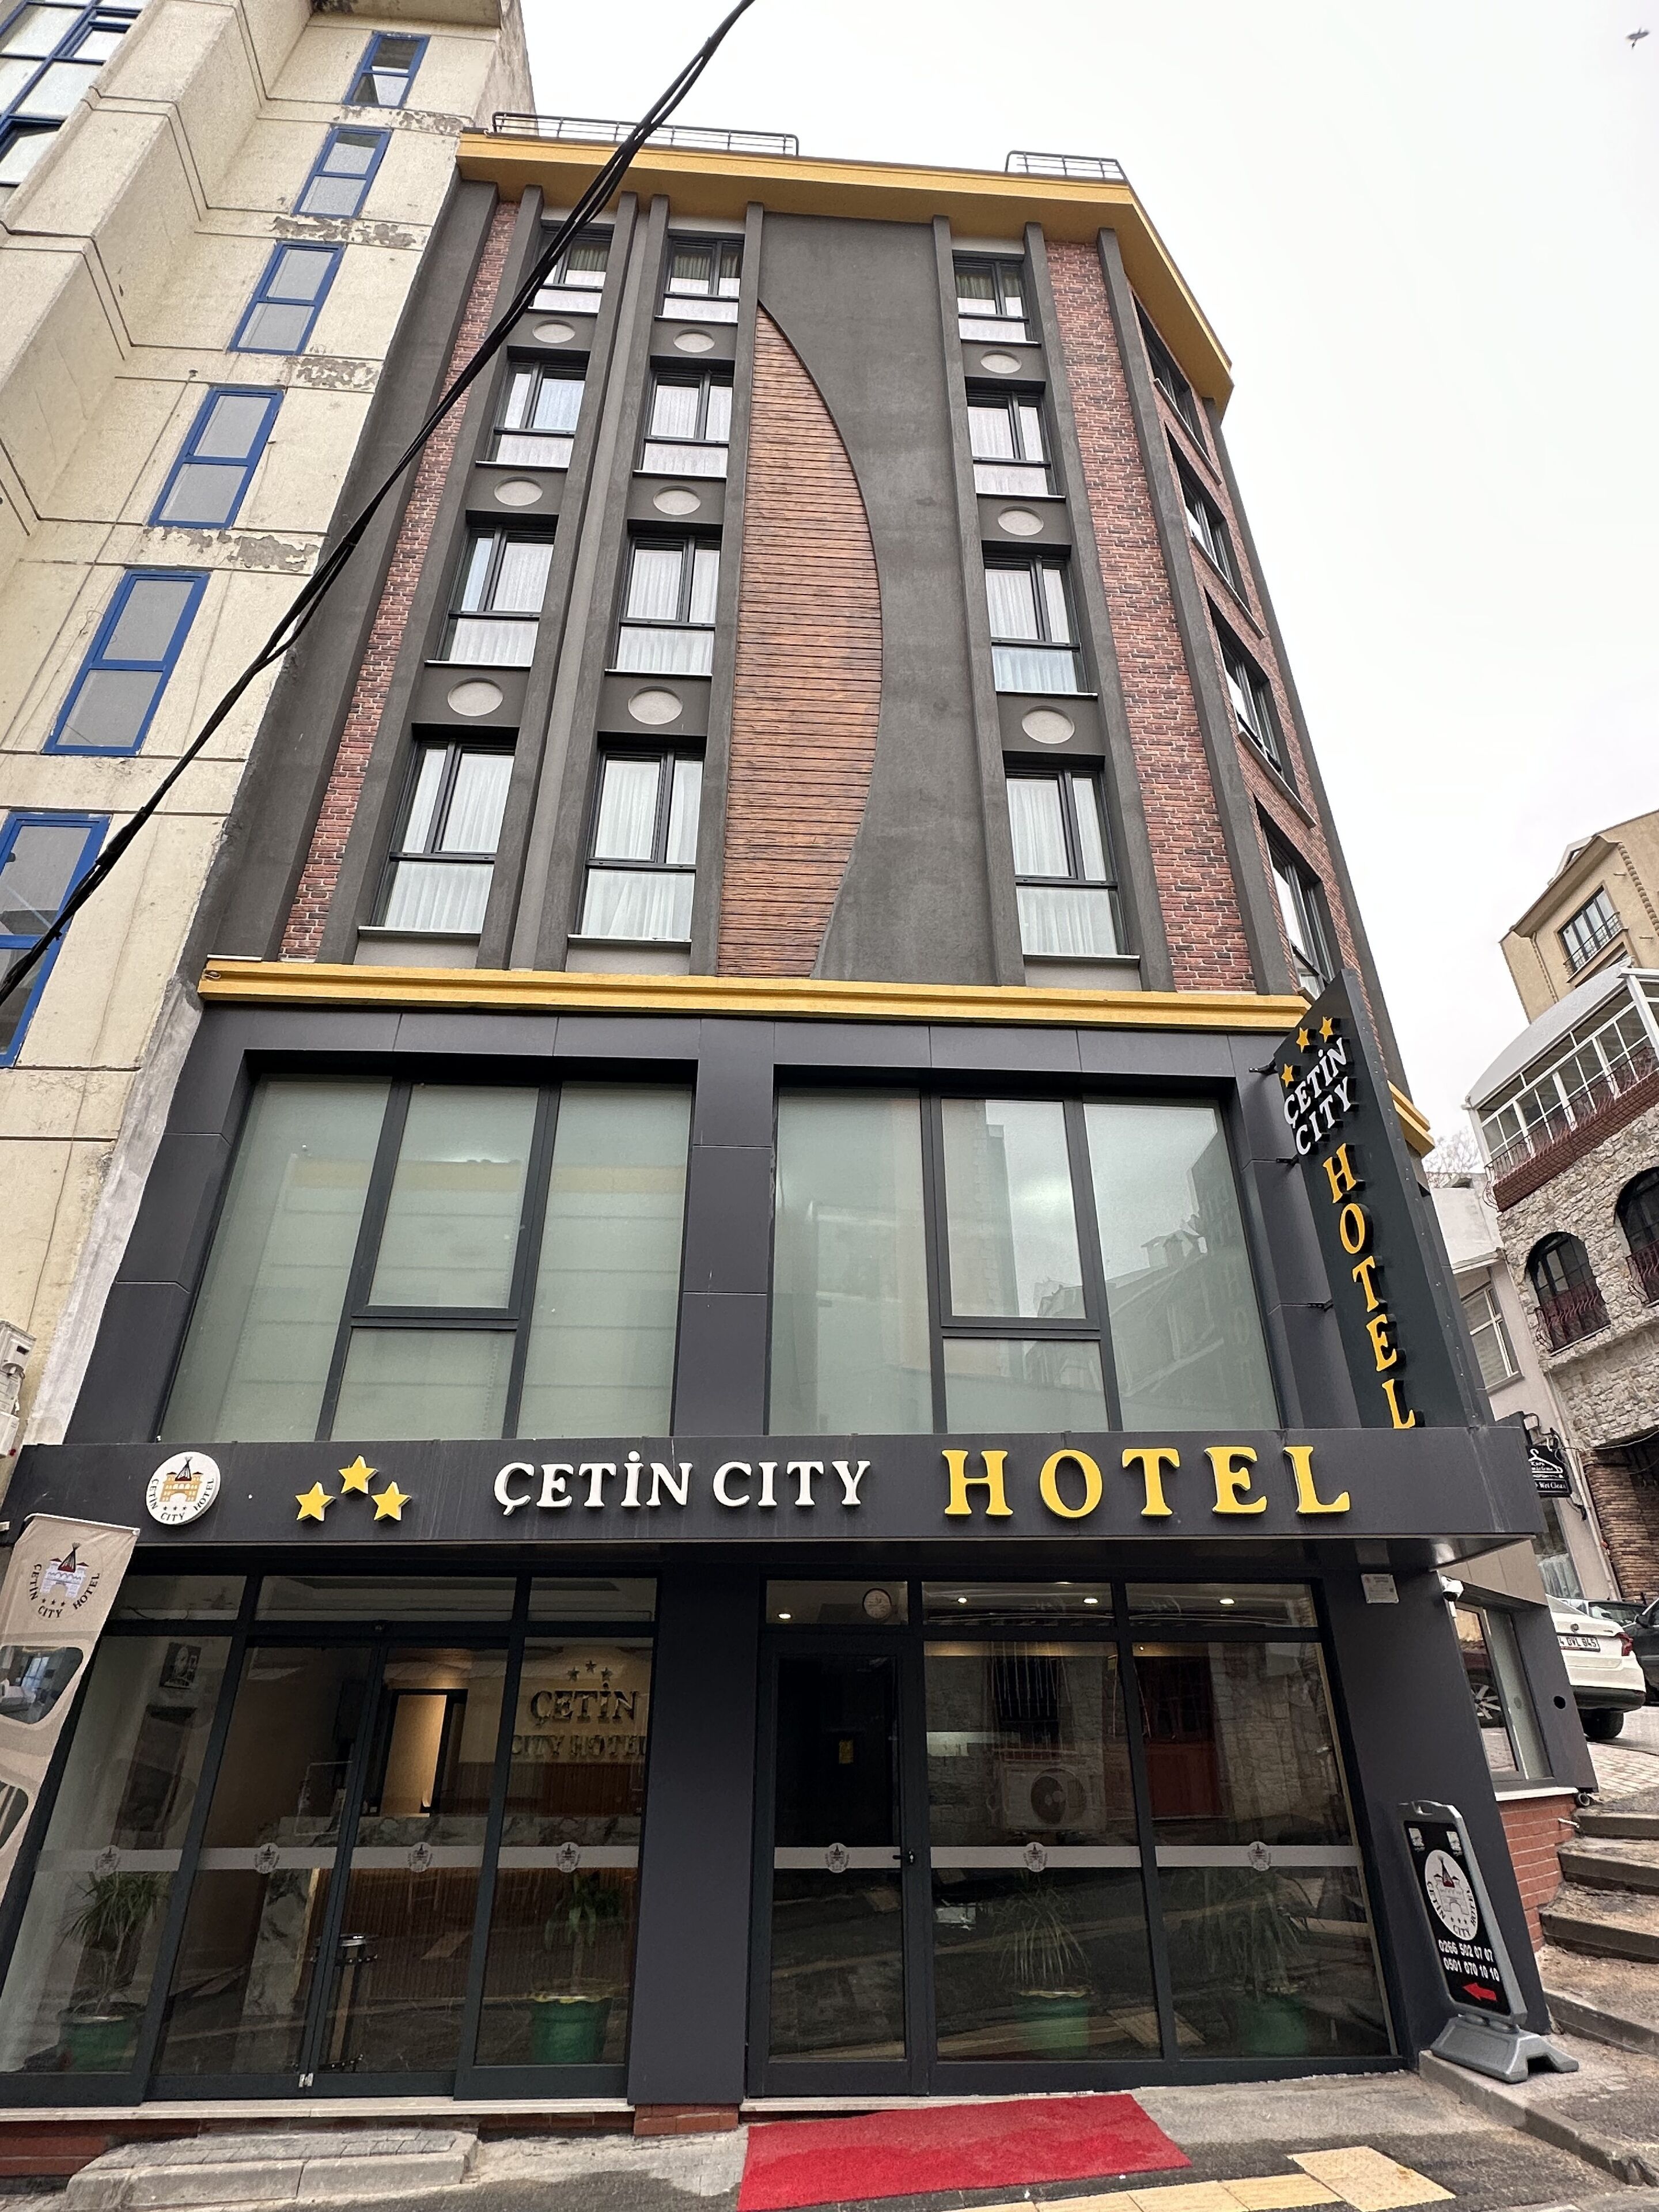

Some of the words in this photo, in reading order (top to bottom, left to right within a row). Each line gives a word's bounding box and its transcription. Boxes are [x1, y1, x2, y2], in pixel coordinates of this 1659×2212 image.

[1284, 1037, 1346, 1128] ÇETİN
[1296, 1076, 1351, 1156] CITY
[1322, 1142, 1415, 1429] HOTEL
[161, 1512, 185, 1522] CITY
[193, 1478, 214, 1511] HOTEL
[494, 1450, 692, 1516] ÇETİN
[713, 1460, 871, 1508] CITY
[941, 1445, 1351, 1519] HOTEL
[37, 1605, 63, 1618] CITY
[73, 1573, 100, 1610] HOTEL
[1444, 1957, 1463, 1972] 0501
[1464, 1961, 1478, 1976] 070
[1479, 1964, 1488, 1979] 10
[1490, 1967, 1500, 1982] 10
[1474, 1945, 1483, 1960] 07
[1484, 1948, 1494, 1963] 07
